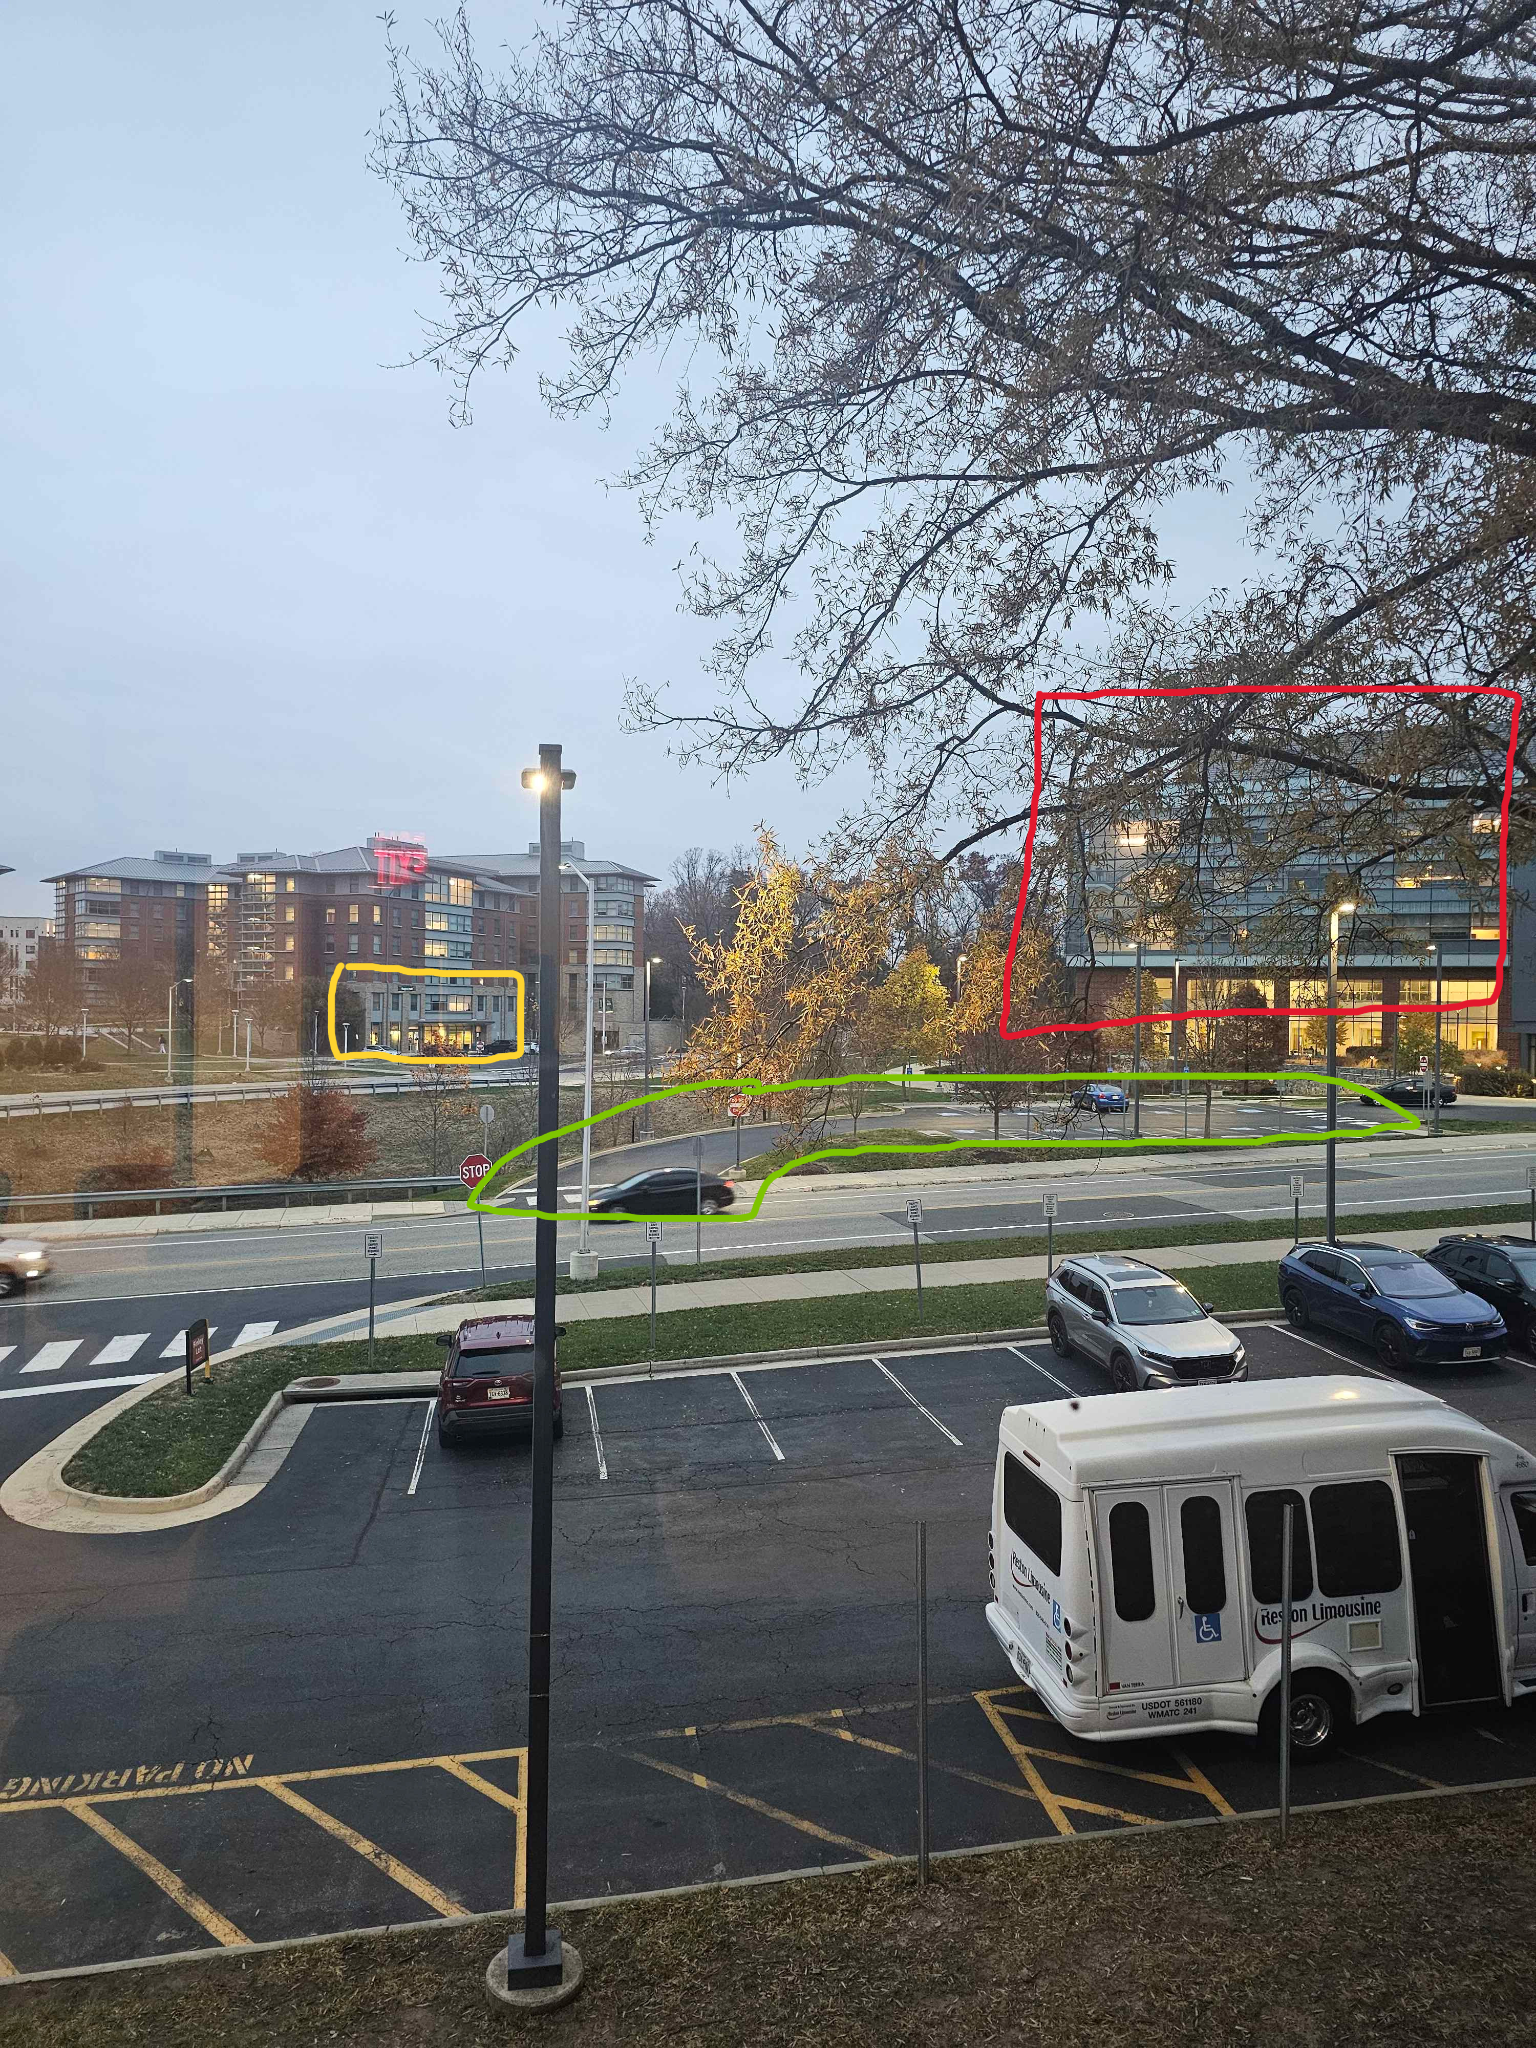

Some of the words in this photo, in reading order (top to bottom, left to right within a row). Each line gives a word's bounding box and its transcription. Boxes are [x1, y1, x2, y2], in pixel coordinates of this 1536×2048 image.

[462, 1164, 490, 1180] STOP
[1261, 1608, 1307, 1626] Reson
[1312, 1600, 1382, 1621] Limousine
[1141, 1700, 1171, 1710] USDOT
[1174, 1697, 1202, 1707] 561180
[1148, 1709, 1180, 1719] WMATC
[1183, 1707, 1197, 1715] 241
[194, 1753, 255, 1780] NO
[0, 1760, 186, 1800] PARKING
